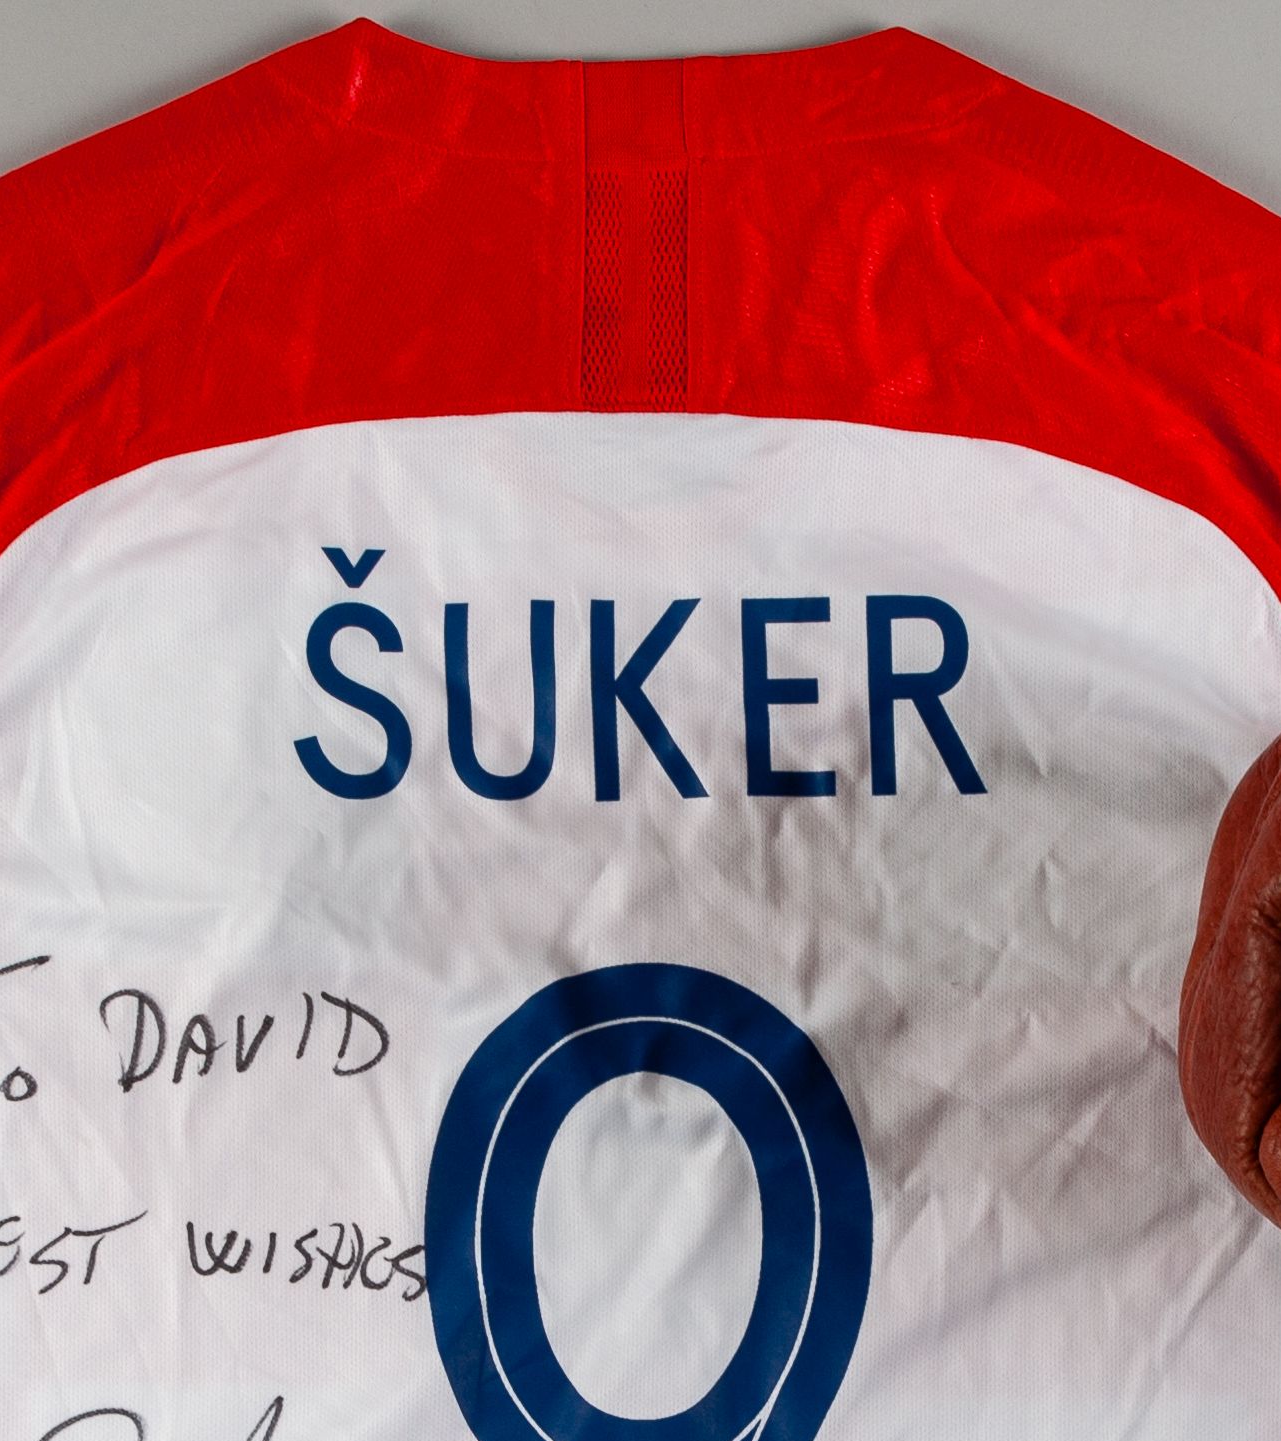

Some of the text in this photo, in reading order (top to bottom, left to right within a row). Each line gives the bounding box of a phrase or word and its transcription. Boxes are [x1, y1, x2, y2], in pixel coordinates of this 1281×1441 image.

[293, 546, 988, 802] ŠUKER
[99, 988, 390, 1093] DAVID
[186, 1221, 428, 1302] WISHES
